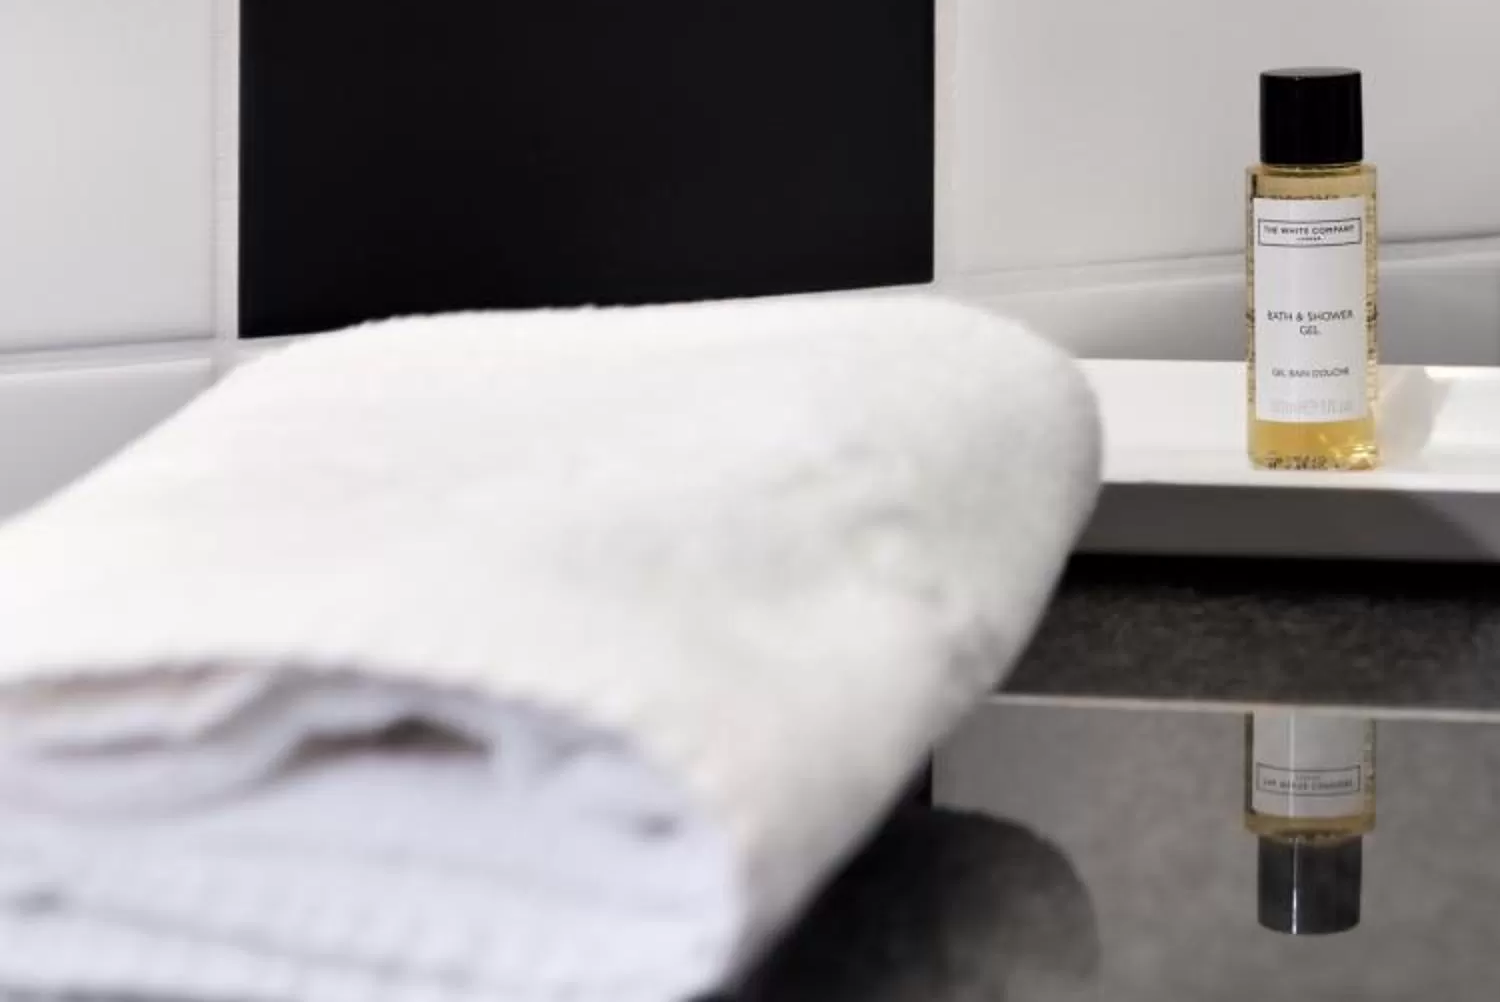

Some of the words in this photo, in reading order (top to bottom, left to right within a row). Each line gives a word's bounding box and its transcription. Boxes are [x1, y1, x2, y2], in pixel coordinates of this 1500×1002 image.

[1263, 225, 1278, 235] THE
[1280, 226, 1309, 236] WHITE
[1311, 224, 1356, 236] COMPANY
[1267, 309, 1293, 321] BATH
[1296, 311, 1304, 321] &
[1307, 309, 1354, 321] SHOWER
[1299, 325, 1322, 336] GEL
